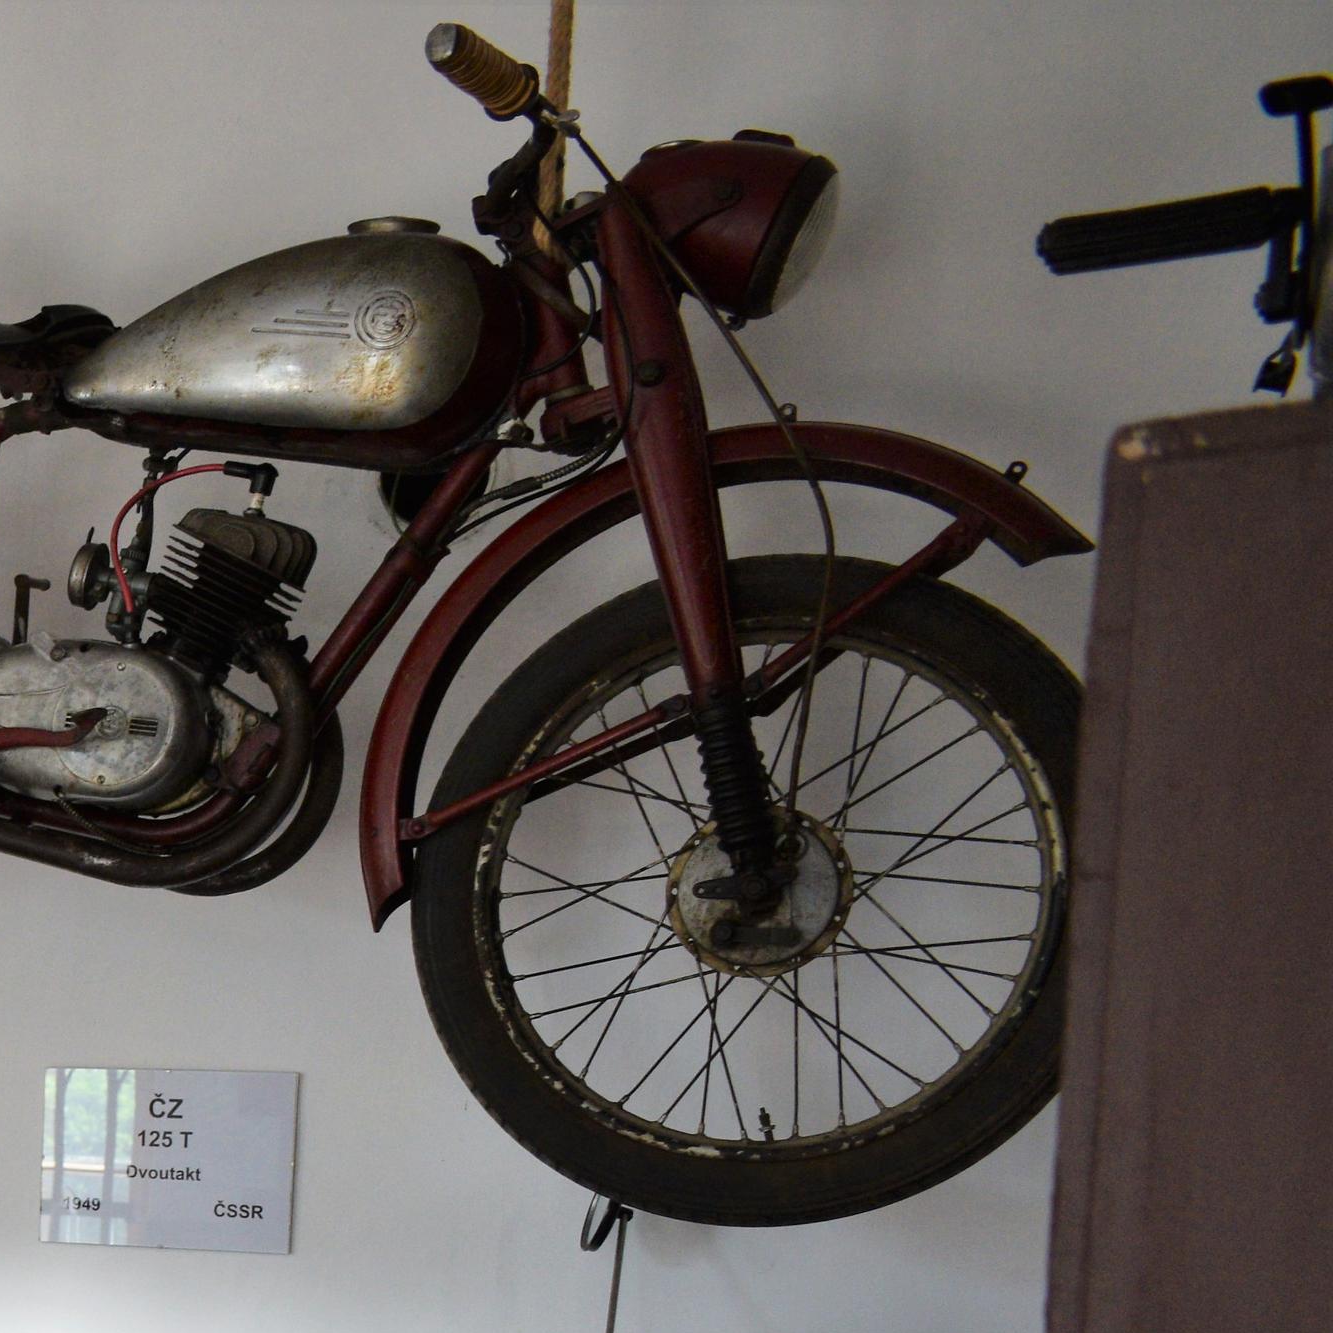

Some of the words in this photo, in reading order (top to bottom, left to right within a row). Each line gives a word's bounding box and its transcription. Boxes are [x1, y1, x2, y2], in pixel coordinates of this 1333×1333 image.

[148, 1093, 184, 1120] ČZ
[137, 1130, 173, 1148] 125
[180, 1131, 193, 1149] T
[126, 1164, 202, 1182] Dvoutakt
[63, 1196, 101, 1212] 1949
[213, 1200, 264, 1220] ČSSR
